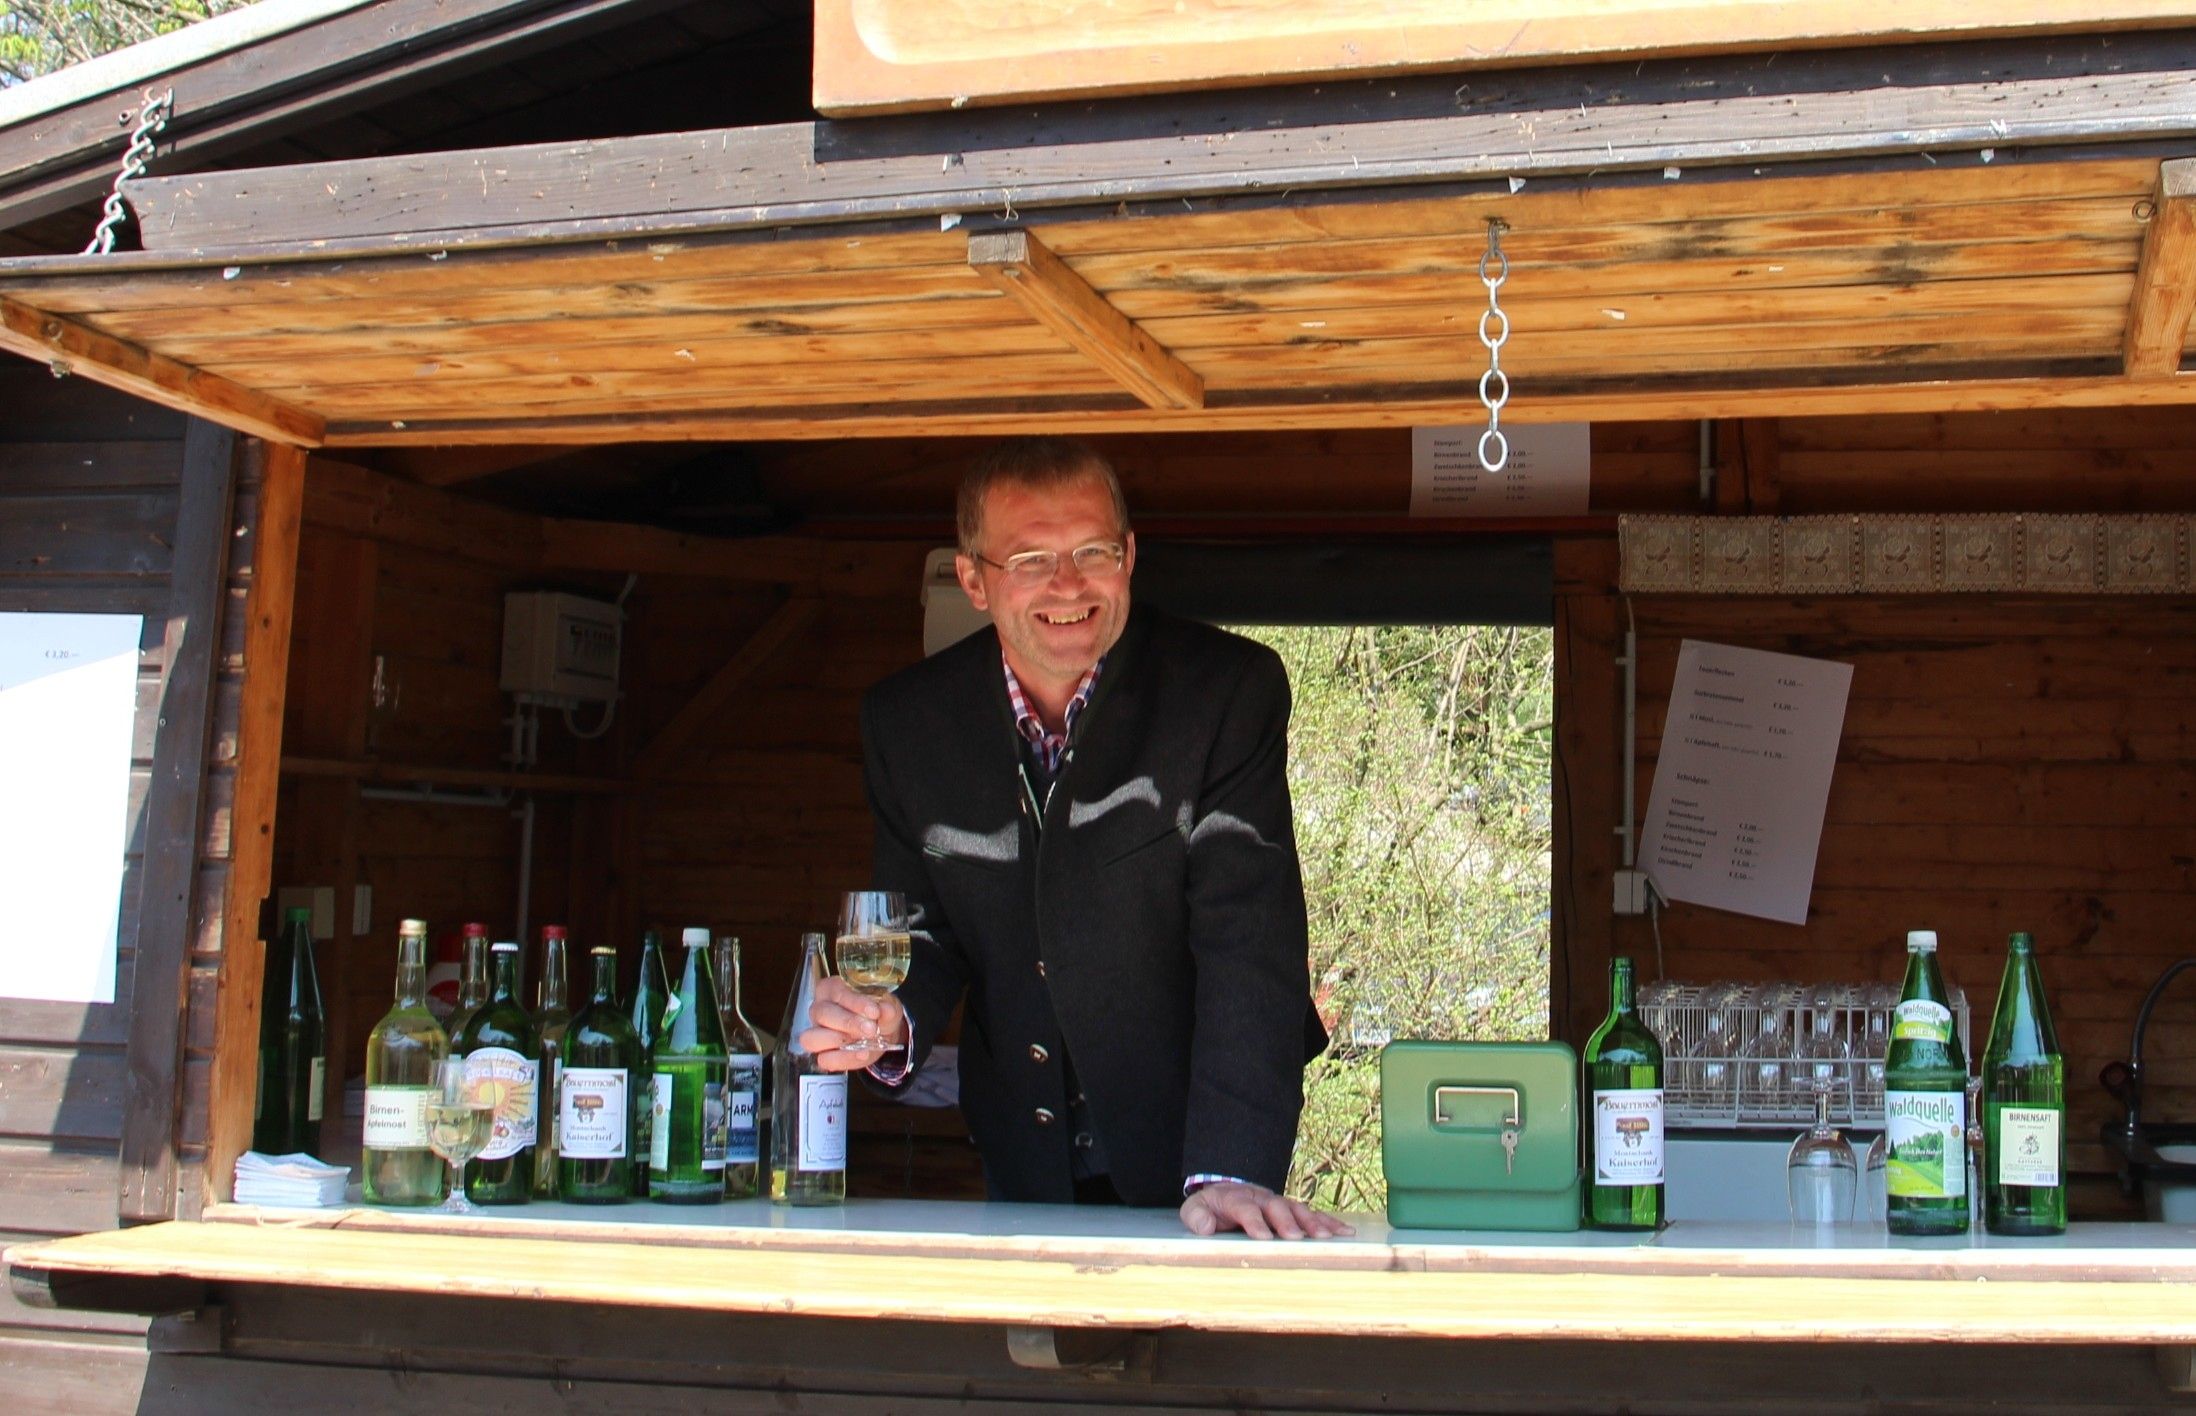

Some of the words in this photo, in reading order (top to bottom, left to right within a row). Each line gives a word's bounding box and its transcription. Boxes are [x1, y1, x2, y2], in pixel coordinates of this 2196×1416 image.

[1904, 1026, 1937, 1038] Spritzig
[2009, 1113, 2051, 1123] BIRNENSAFT
[566, 1132, 614, 1141] Kaiserhof
[1609, 1157, 1658, 1168] Kaiserhof
